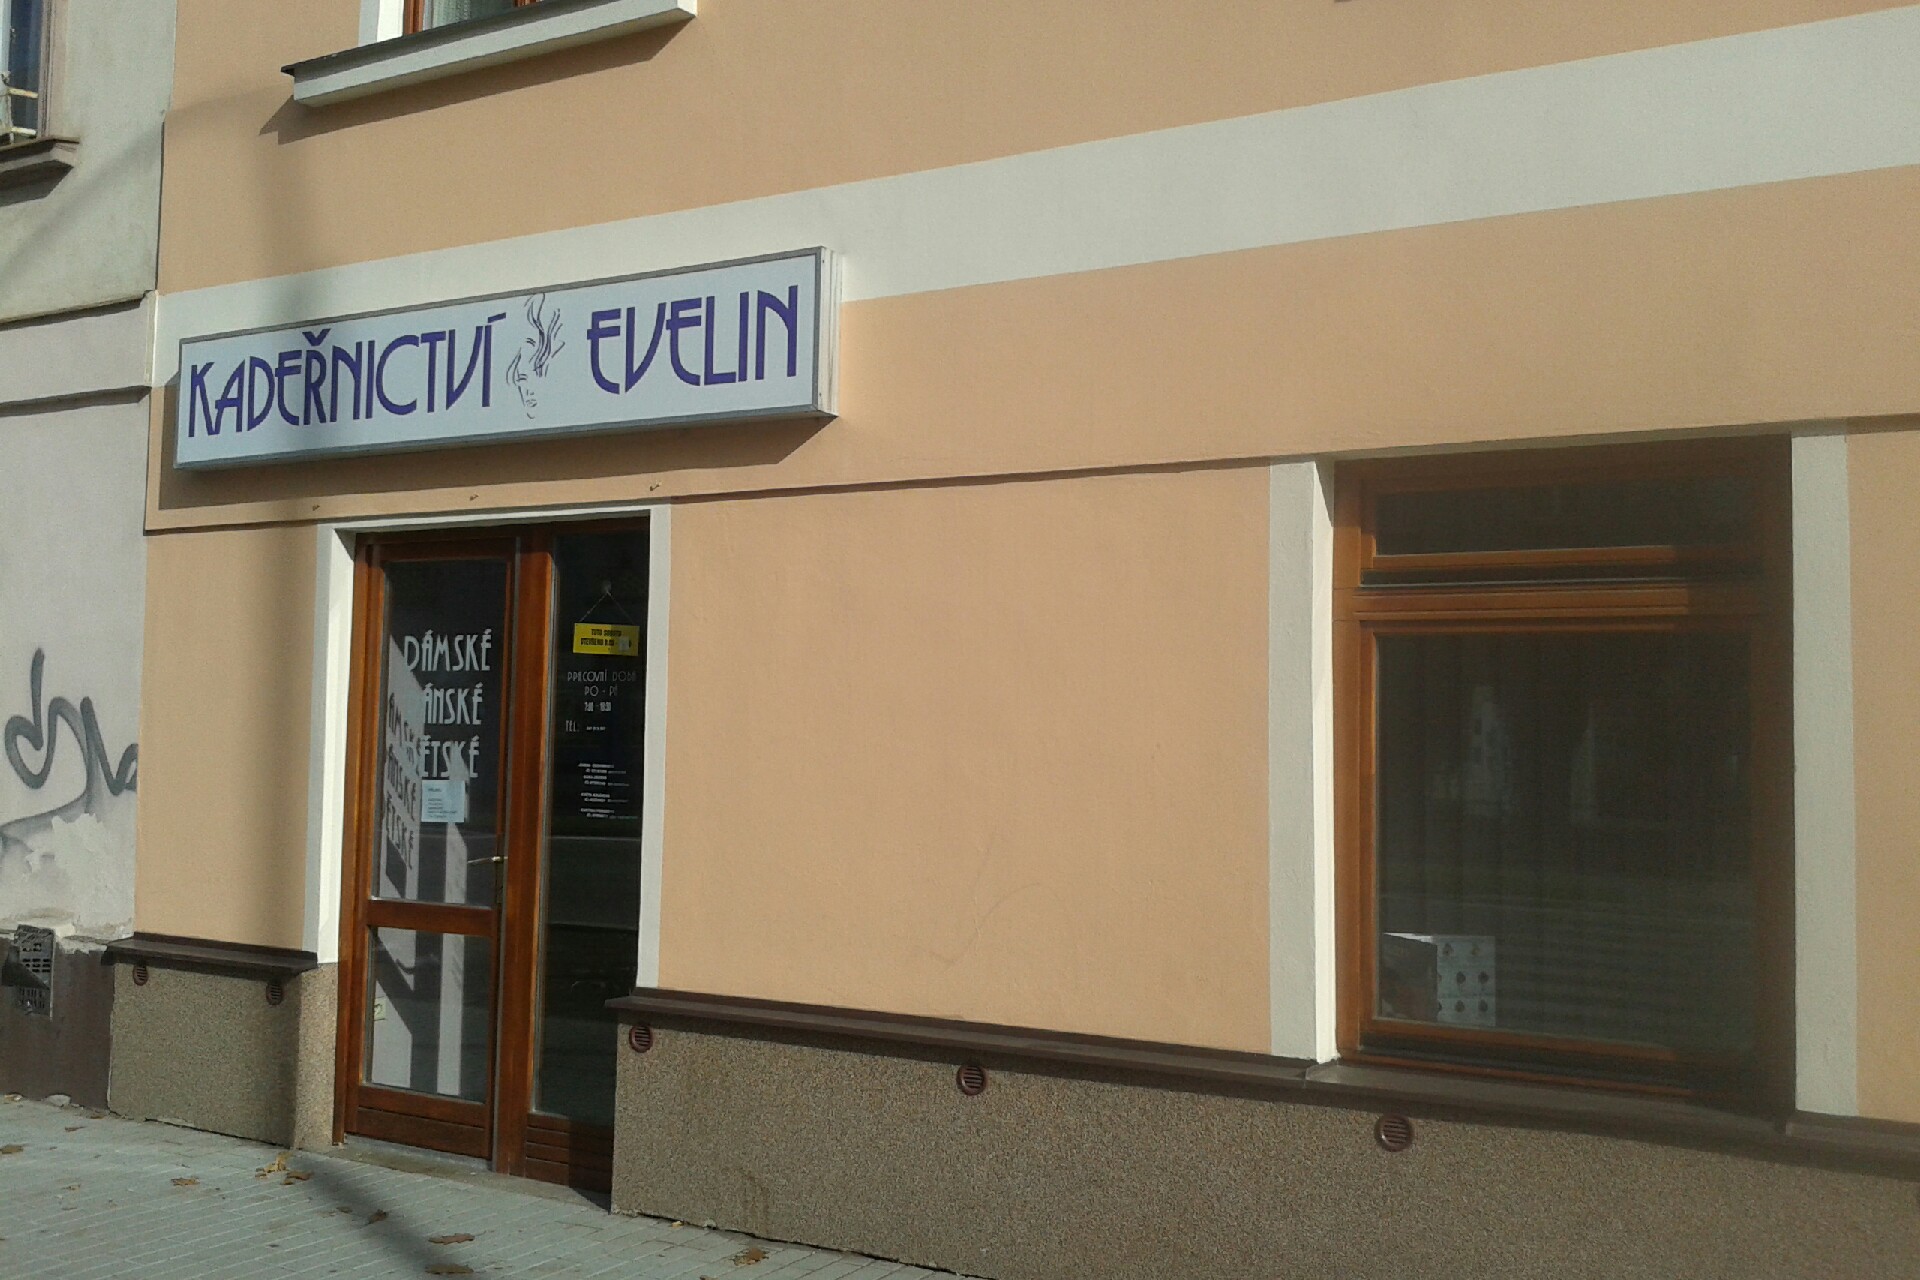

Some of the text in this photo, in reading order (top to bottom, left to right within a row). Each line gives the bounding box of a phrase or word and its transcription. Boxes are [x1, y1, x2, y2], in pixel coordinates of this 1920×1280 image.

[188, 284, 799, 438] KADEŘNICTVÍ EVELIN
[403, 628, 492, 672] DÁMSKÉ
[420, 682, 483, 726] ÁNSKÉ
